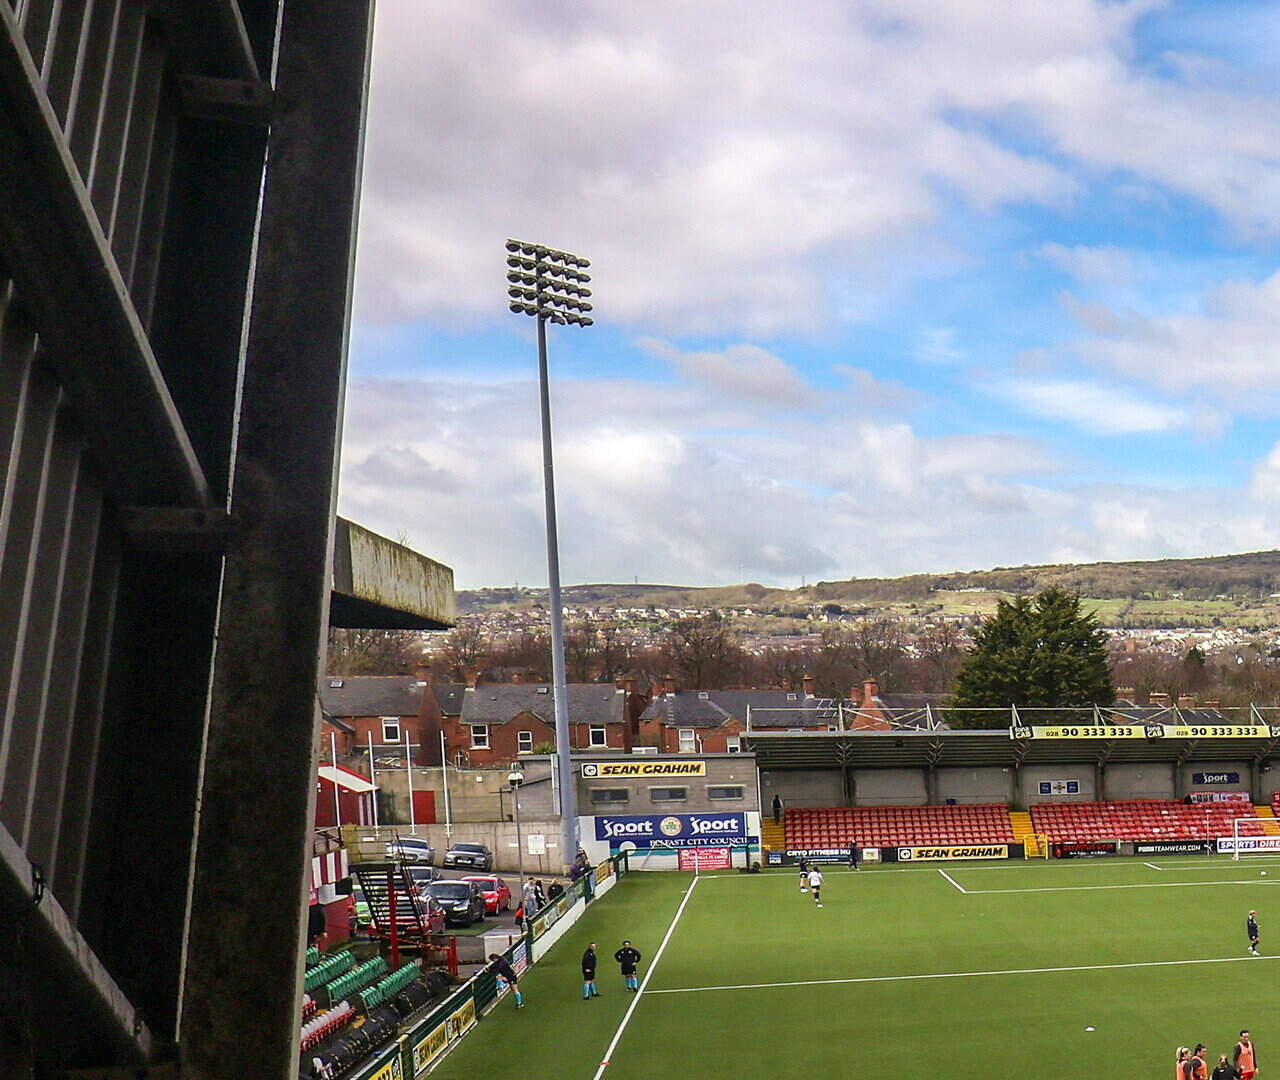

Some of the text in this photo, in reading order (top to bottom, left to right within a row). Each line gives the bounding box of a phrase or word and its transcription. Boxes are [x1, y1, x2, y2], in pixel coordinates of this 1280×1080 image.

[1062, 728, 1079, 736] 90
[1083, 728, 1105, 736] 333
[1110, 728, 1133, 736] 333
[602, 765, 640, 775] SEAN
[642, 764, 701, 774] GRAHAM
[689, 837, 709, 846] CITY
[1220, 840, 1255, 849] SPORTS
[916, 849, 949, 858] SEAN
[952, 847, 1003, 857] GRAHAM
